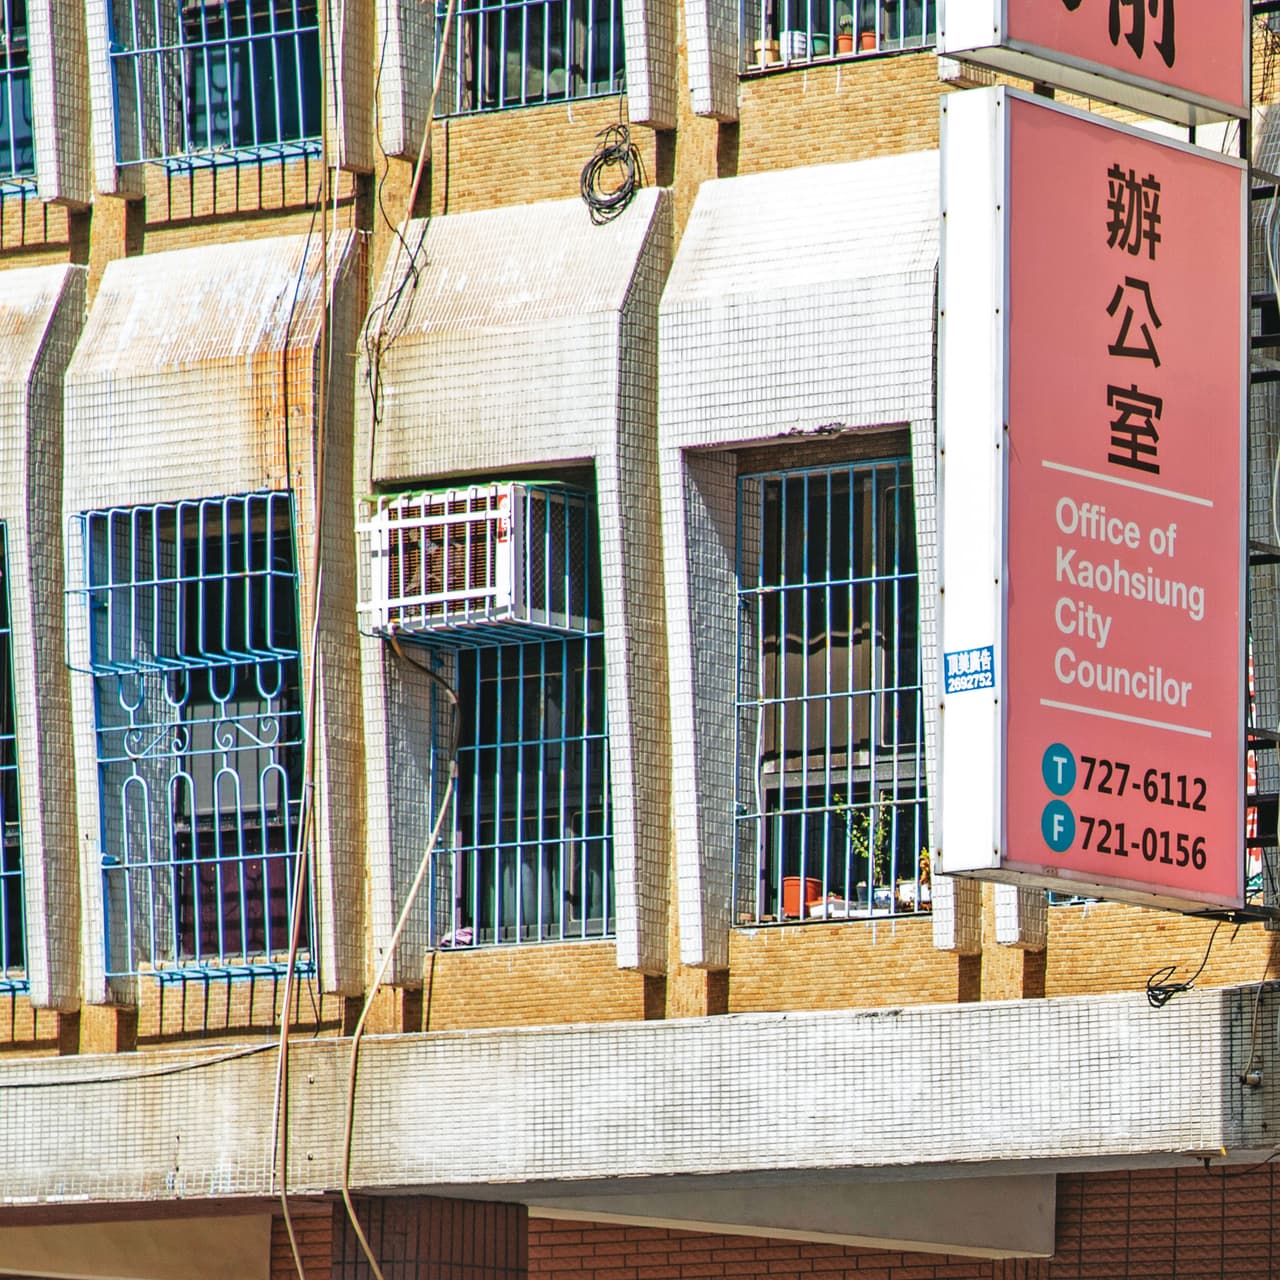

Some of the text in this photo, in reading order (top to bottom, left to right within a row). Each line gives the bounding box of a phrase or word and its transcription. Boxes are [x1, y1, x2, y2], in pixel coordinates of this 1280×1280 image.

[1106, 163, 1163, 475] 辦公室
[1055, 497, 1177, 557] Office of
[1055, 546, 1206, 621] Kaohsiung
[1055, 597, 1112, 648] City
[1054, 646, 1193, 707] Councilor
[1052, 756, 1208, 811] T 727-6112
[1052, 814, 1208, 870] F 721-0156
